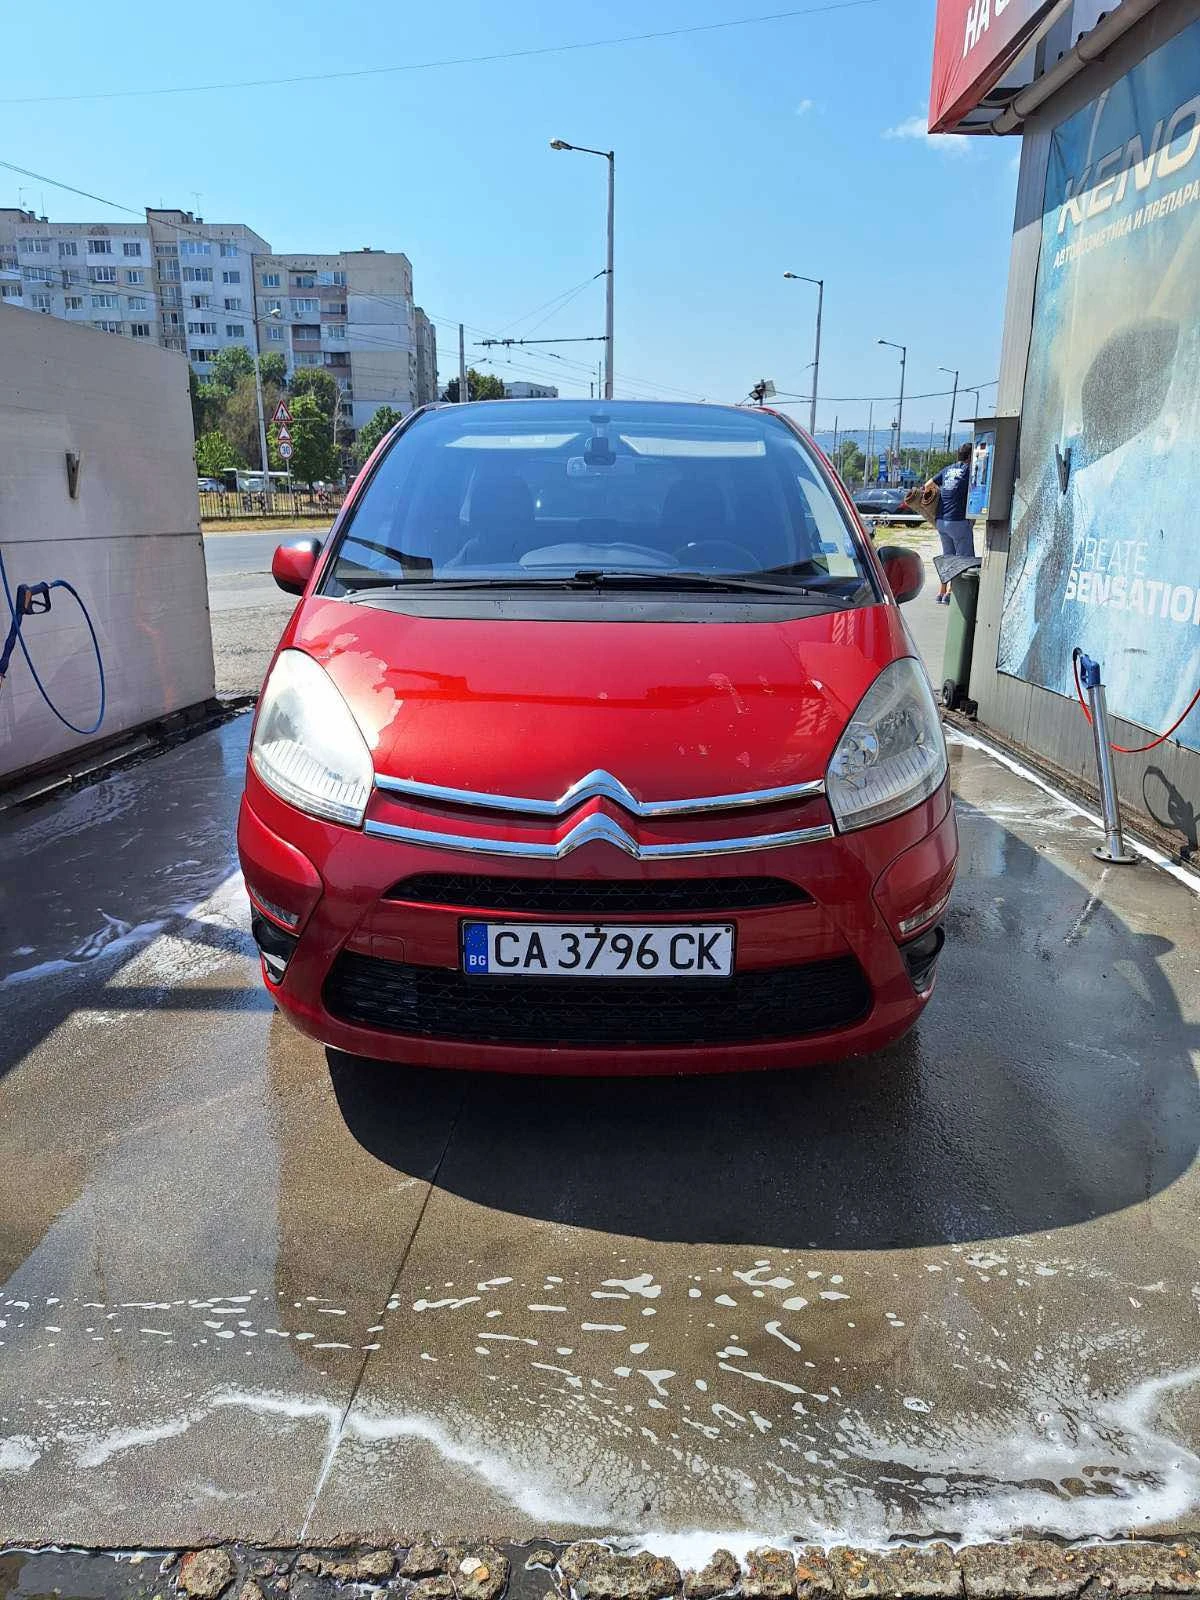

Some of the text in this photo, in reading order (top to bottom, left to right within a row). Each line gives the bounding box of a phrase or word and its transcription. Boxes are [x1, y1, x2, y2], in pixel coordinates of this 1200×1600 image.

[963, 0, 990, 58] НА
[281, 446, 291, 455] 30
[469, 955, 486, 966] BG
[494, 932, 722, 970] CA 3796 CK
